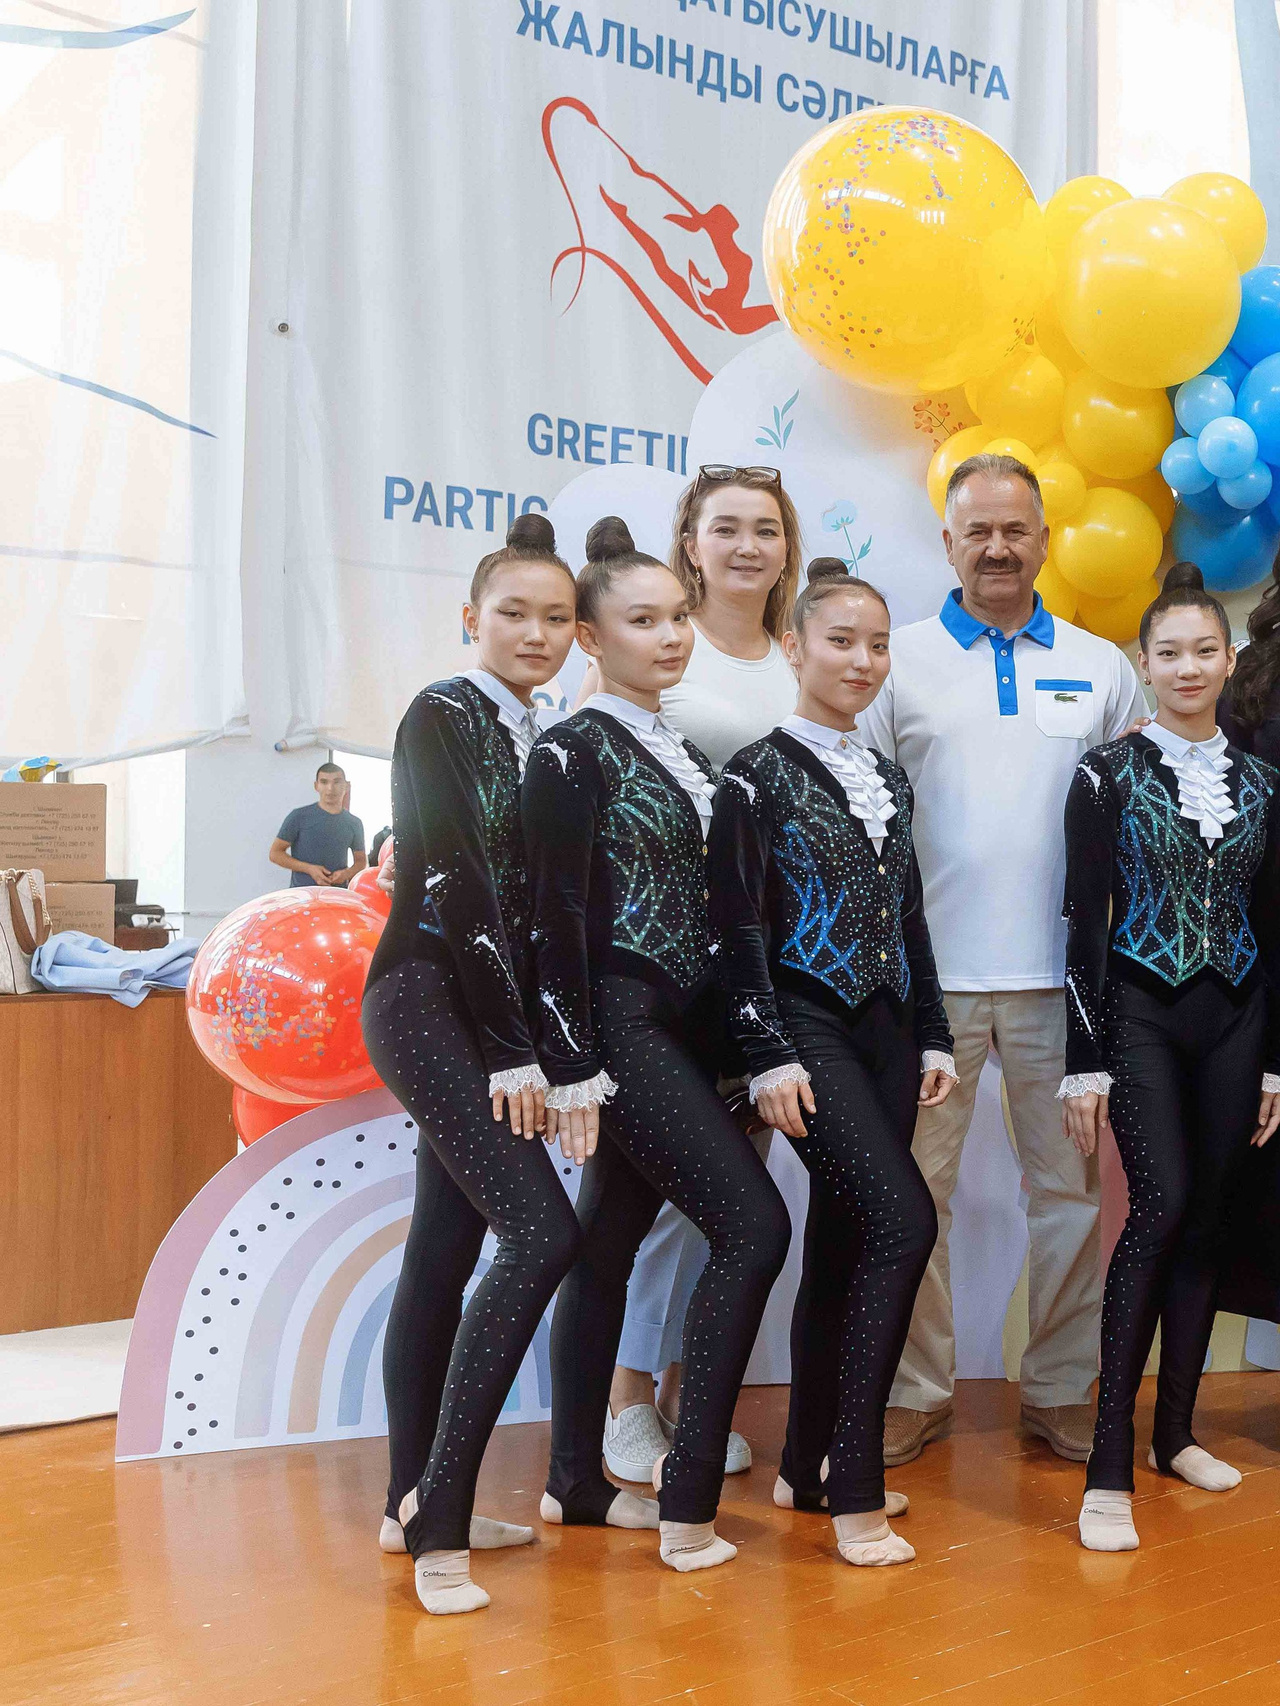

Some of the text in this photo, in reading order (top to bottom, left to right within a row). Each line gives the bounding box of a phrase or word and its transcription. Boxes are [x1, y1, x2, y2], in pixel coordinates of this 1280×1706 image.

[516, 0, 884, 123] ЖАЛЫНДЫ СӘЛ
[677, 0, 1010, 100] ЫСУШЫЛАРҒА
